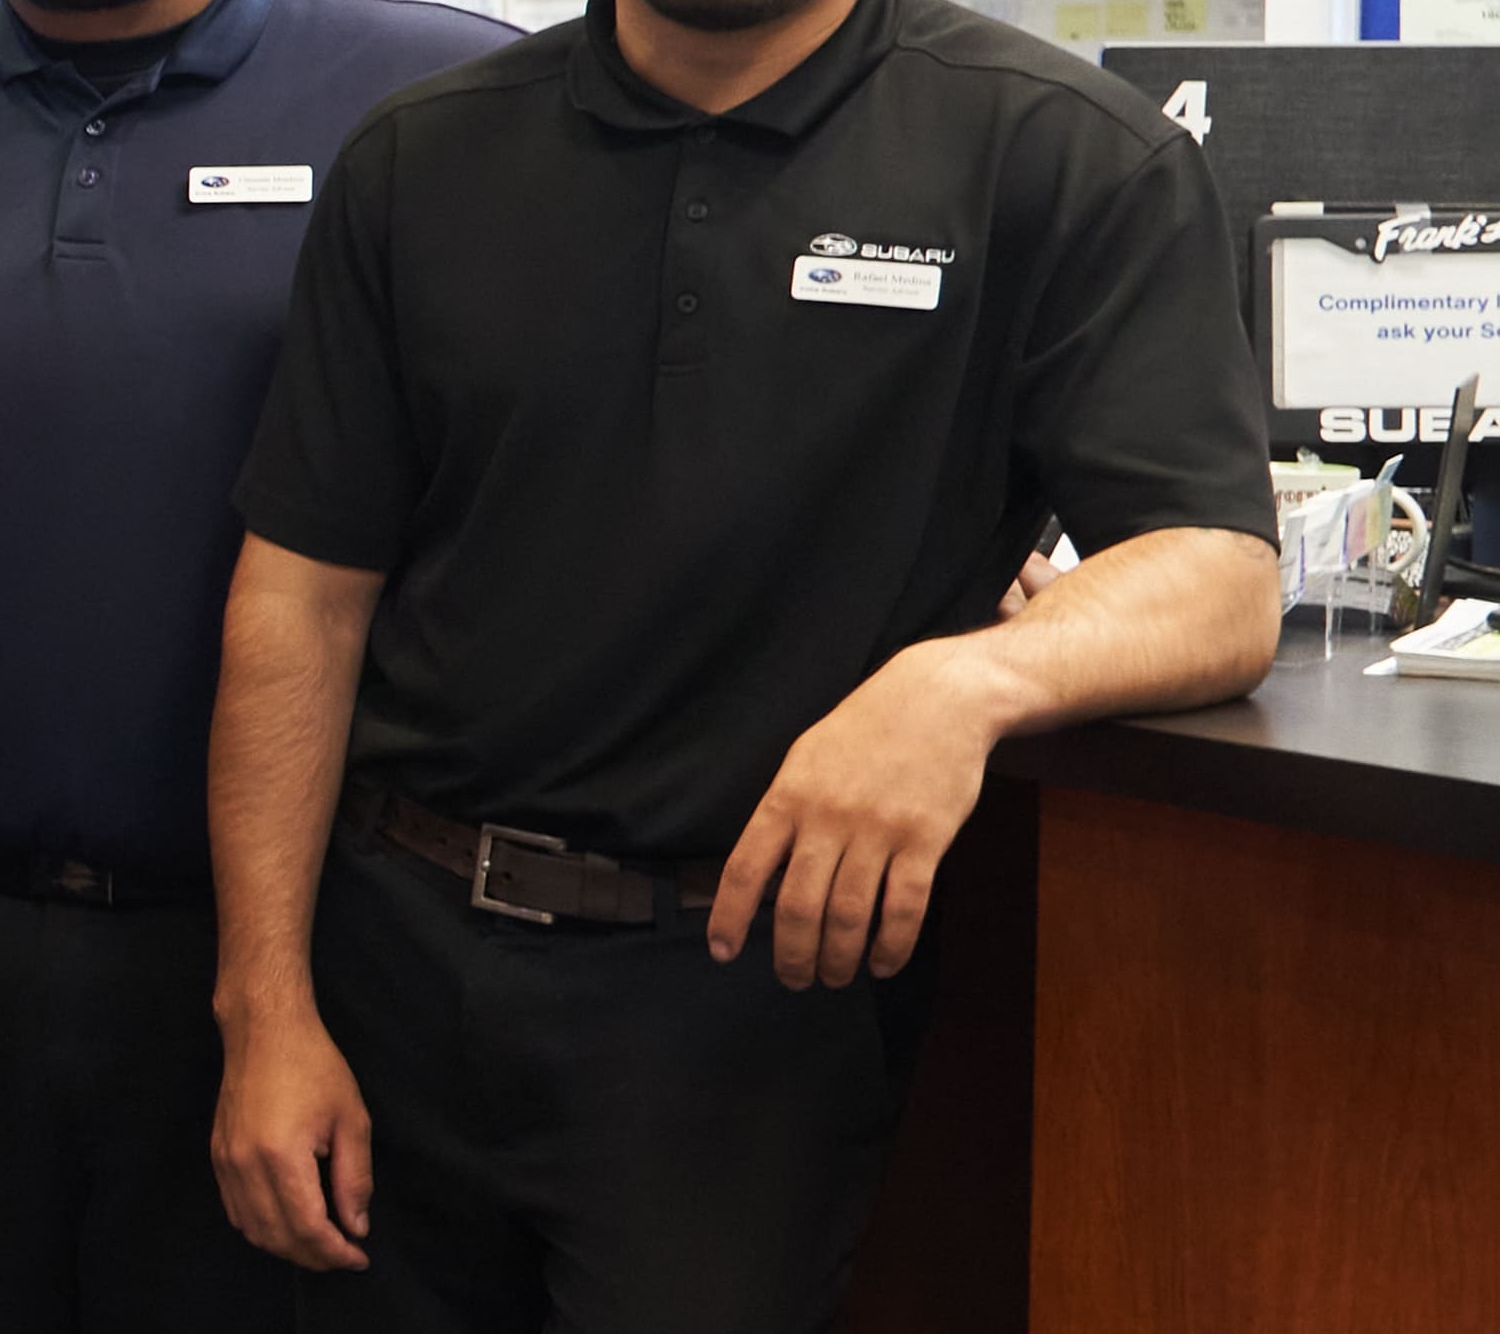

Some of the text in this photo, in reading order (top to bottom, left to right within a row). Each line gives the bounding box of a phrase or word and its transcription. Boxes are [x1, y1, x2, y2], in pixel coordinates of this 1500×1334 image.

[1162, 80, 1212, 146] 4
[861, 243, 955, 264] SUBARU
[1318, 294, 1489, 313] Complimentary
[1377, 323, 1415, 339] ask
[1424, 326, 1473, 343] your
